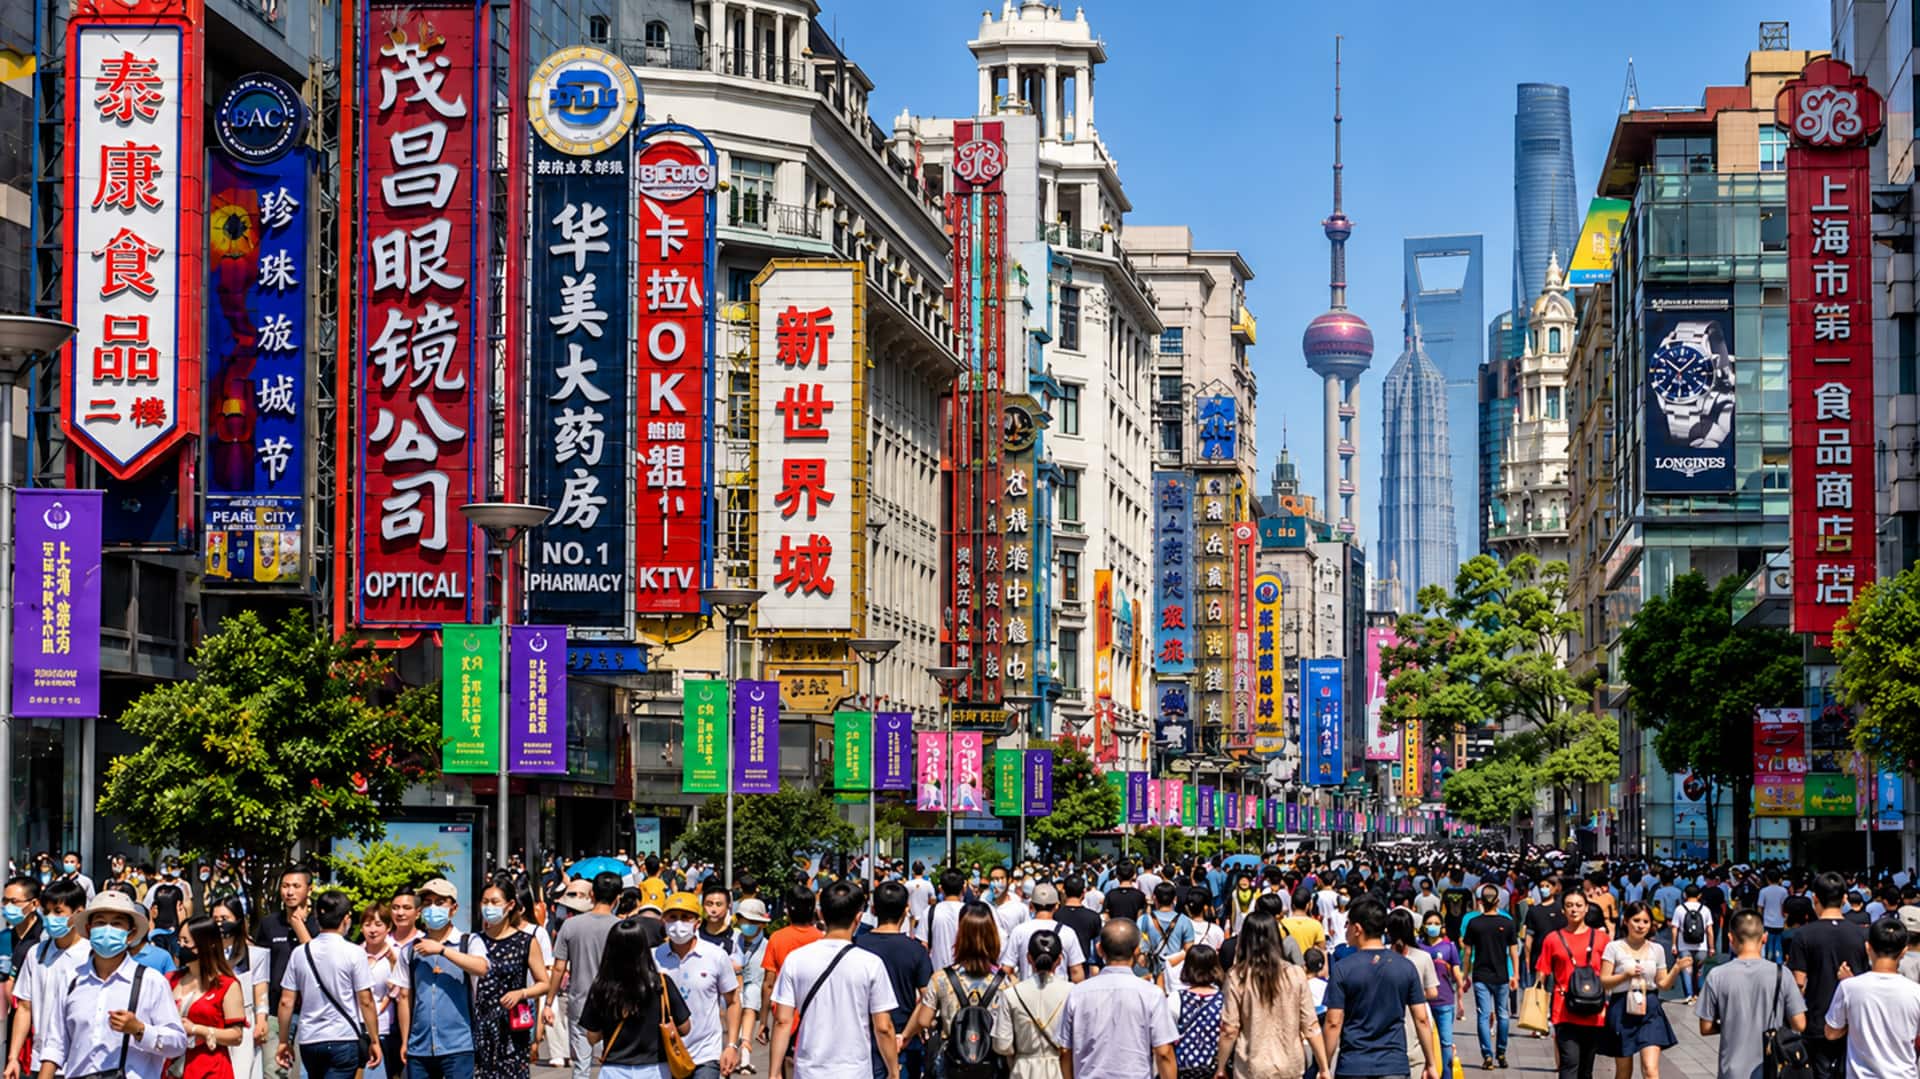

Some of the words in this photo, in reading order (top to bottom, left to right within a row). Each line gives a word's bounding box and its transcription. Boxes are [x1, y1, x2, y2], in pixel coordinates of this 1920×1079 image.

[92, 51, 163, 381] 泰康食品
[368, 42, 467, 550] 茂昌眼镜公司
[256, 187, 299, 481] 珍珠旅城节
[549, 202, 611, 528] 华美大药房
[774, 305, 835, 595] 新世界城
[1655, 456, 1726, 469] LONGINES
[212, 511, 257, 524] PEARL
[263, 511, 295, 523] CITY
[542, 542, 592, 565] NO.
[597, 542, 608, 565] 1
[365, 571, 465, 598] OPTICAL
[530, 573, 622, 592] PHARMACY
[640, 567, 694, 589] KTV
